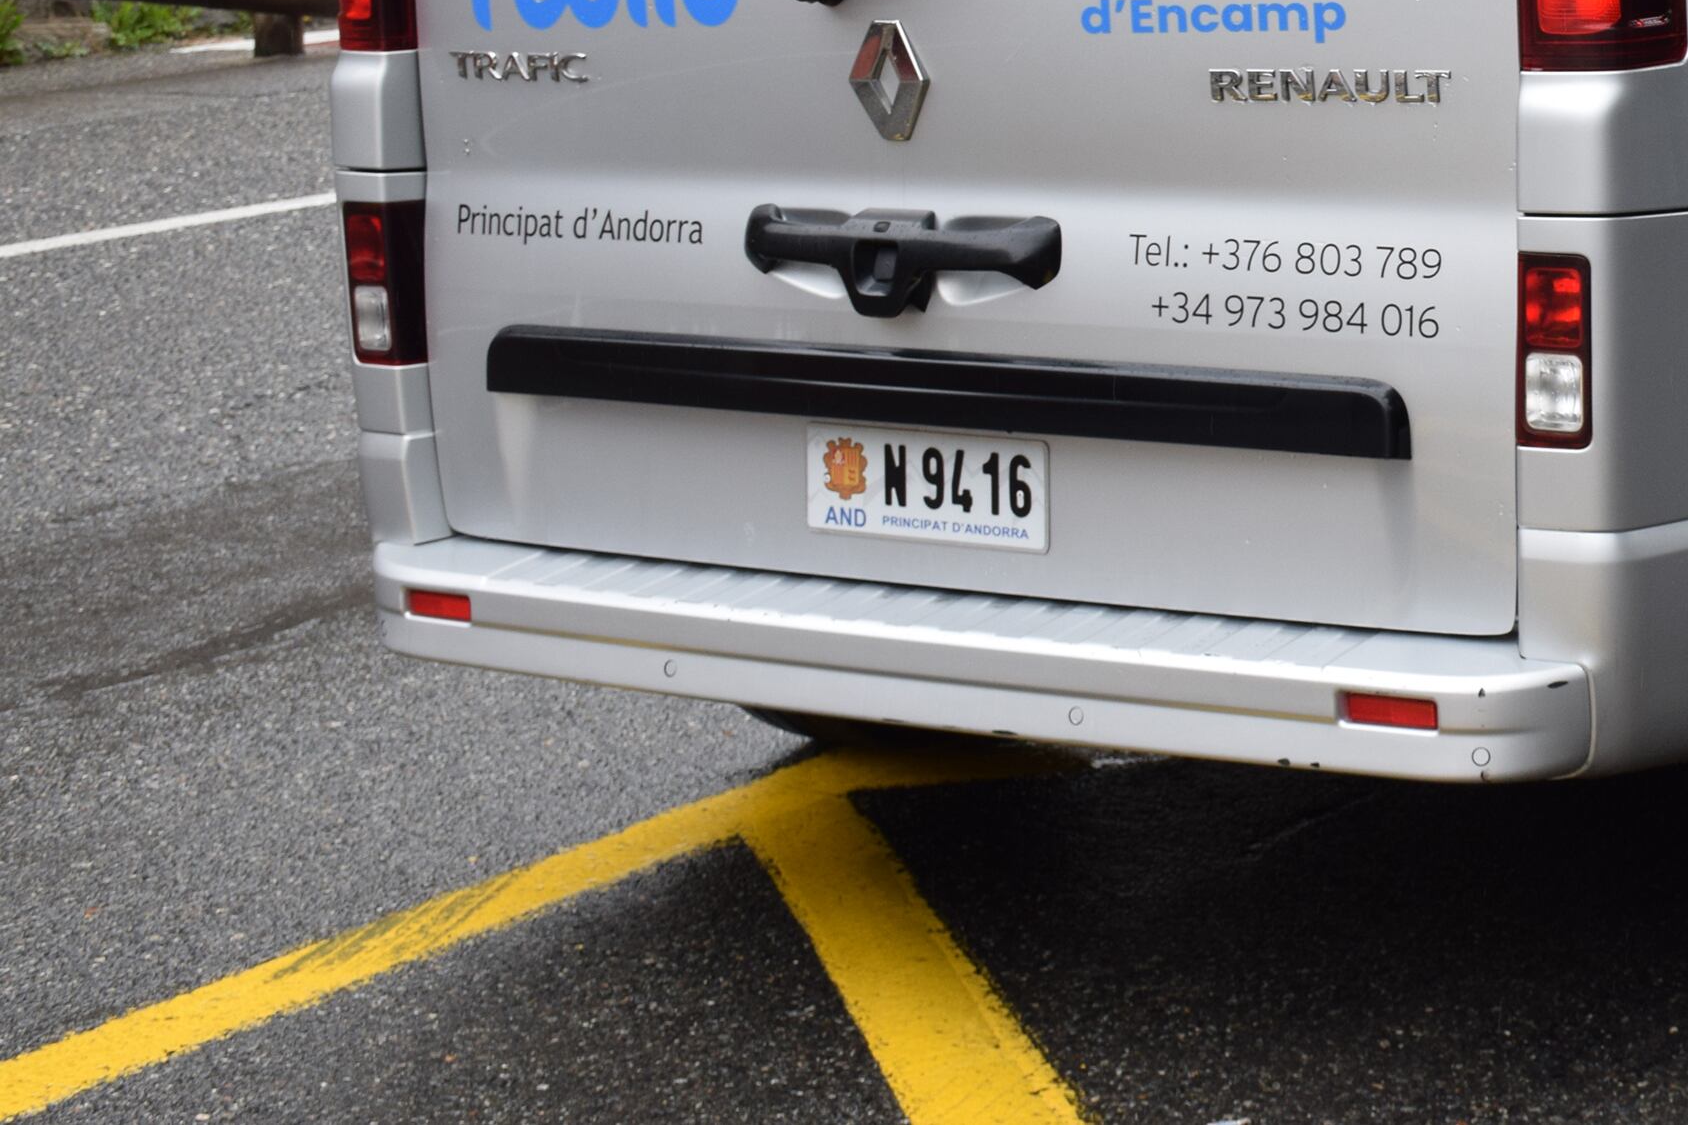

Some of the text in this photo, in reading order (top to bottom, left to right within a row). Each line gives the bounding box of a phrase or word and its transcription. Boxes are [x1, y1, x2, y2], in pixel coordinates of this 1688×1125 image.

[449, 50, 590, 83] TRAFIC
[1208, 67, 1452, 104] RENAULT
[457, 204, 703, 245] Principat d'Andorra
[1129, 234, 1442, 280] Tel.: +376 803 789
[1151, 292, 1440, 339] +34 973 984 016
[884, 443, 1032, 518] N 9416
[825, 506, 867, 528] AND
[882, 515, 1029, 540] PRINCIPAT D'ANDORRA
